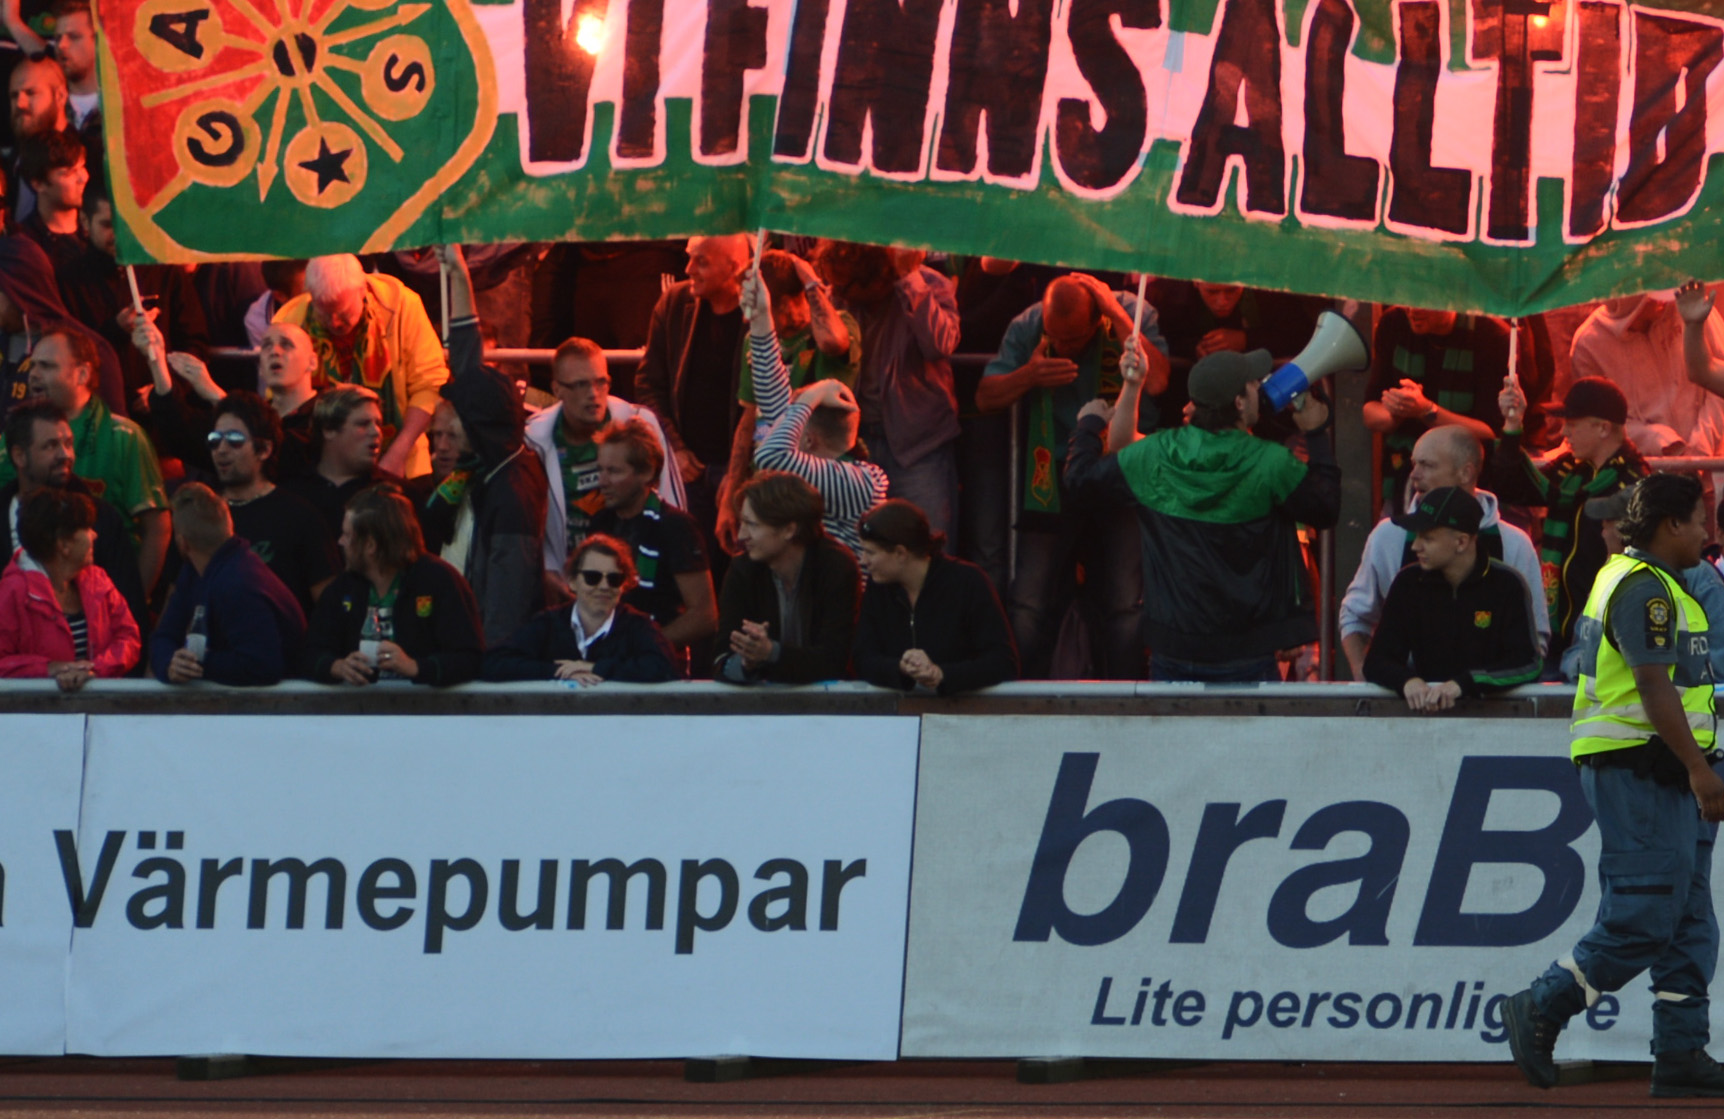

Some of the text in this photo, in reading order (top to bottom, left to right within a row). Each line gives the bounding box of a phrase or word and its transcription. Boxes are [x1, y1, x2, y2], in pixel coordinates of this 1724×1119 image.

[149, 9, 210, 60] A
[383, 53, 426, 94] S
[187, 110, 245, 167] G
[53, 829, 867, 954] Värmepumpar
[1091, 976, 1621, 1041] Lite personlige
